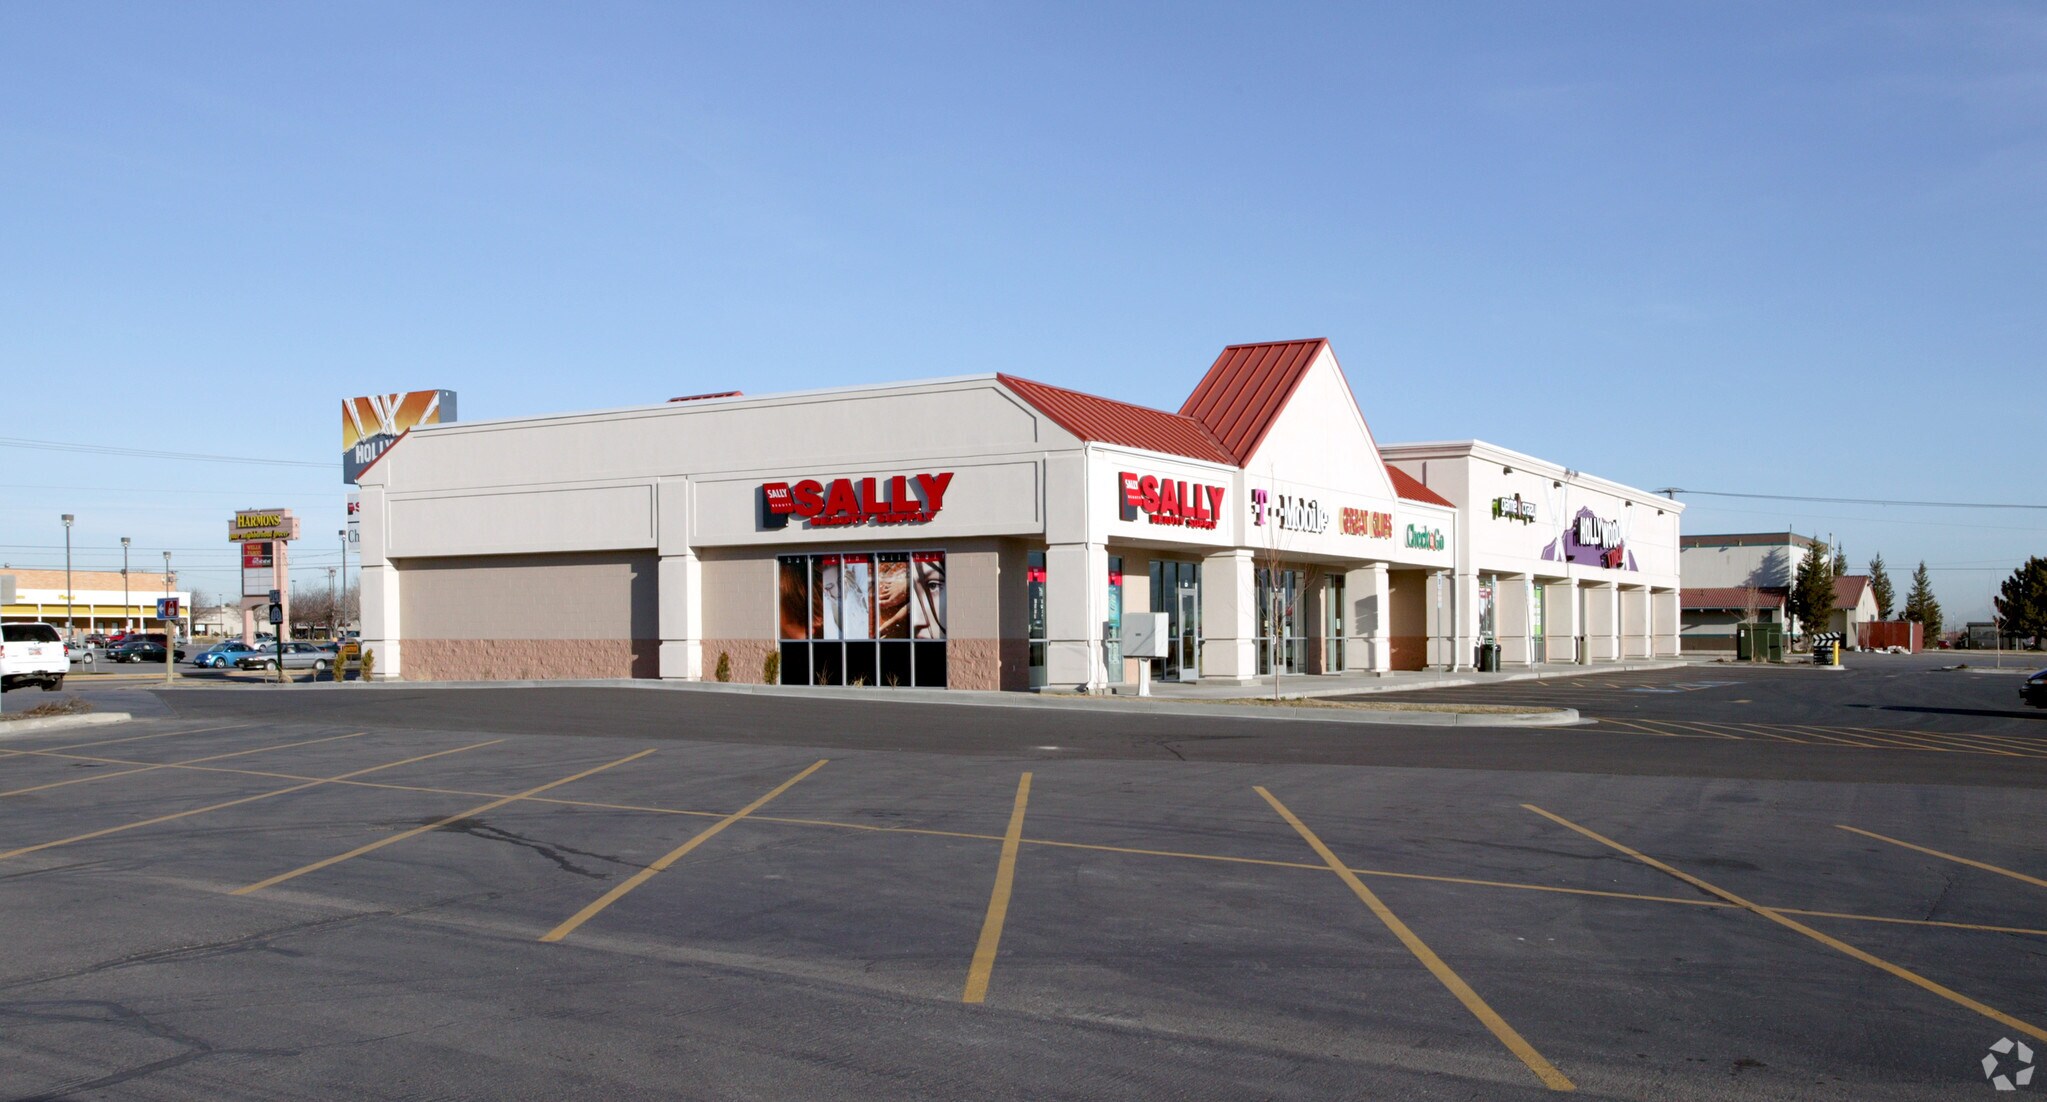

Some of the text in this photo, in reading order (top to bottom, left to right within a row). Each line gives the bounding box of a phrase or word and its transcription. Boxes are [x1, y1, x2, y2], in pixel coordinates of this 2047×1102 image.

[767, 488, 788, 499] SALLY
[794, 472, 954, 517] SALLY
[1141, 474, 1226, 520] SALLY
[1501, 497, 1518, 516] game
[237, 514, 281, 528] HARMONS
[811, 512, 938, 526] BEAUTY SUPPLY
[1150, 514, 1217, 531] BEAUTY SUPPLY
[1341, 507, 1392, 539] GREAT CLIPS
[1406, 523, 1429, 549] Check
[1434, 528, 1445, 550] Go
[1579, 517, 1623, 549] HOLLYWOOD
